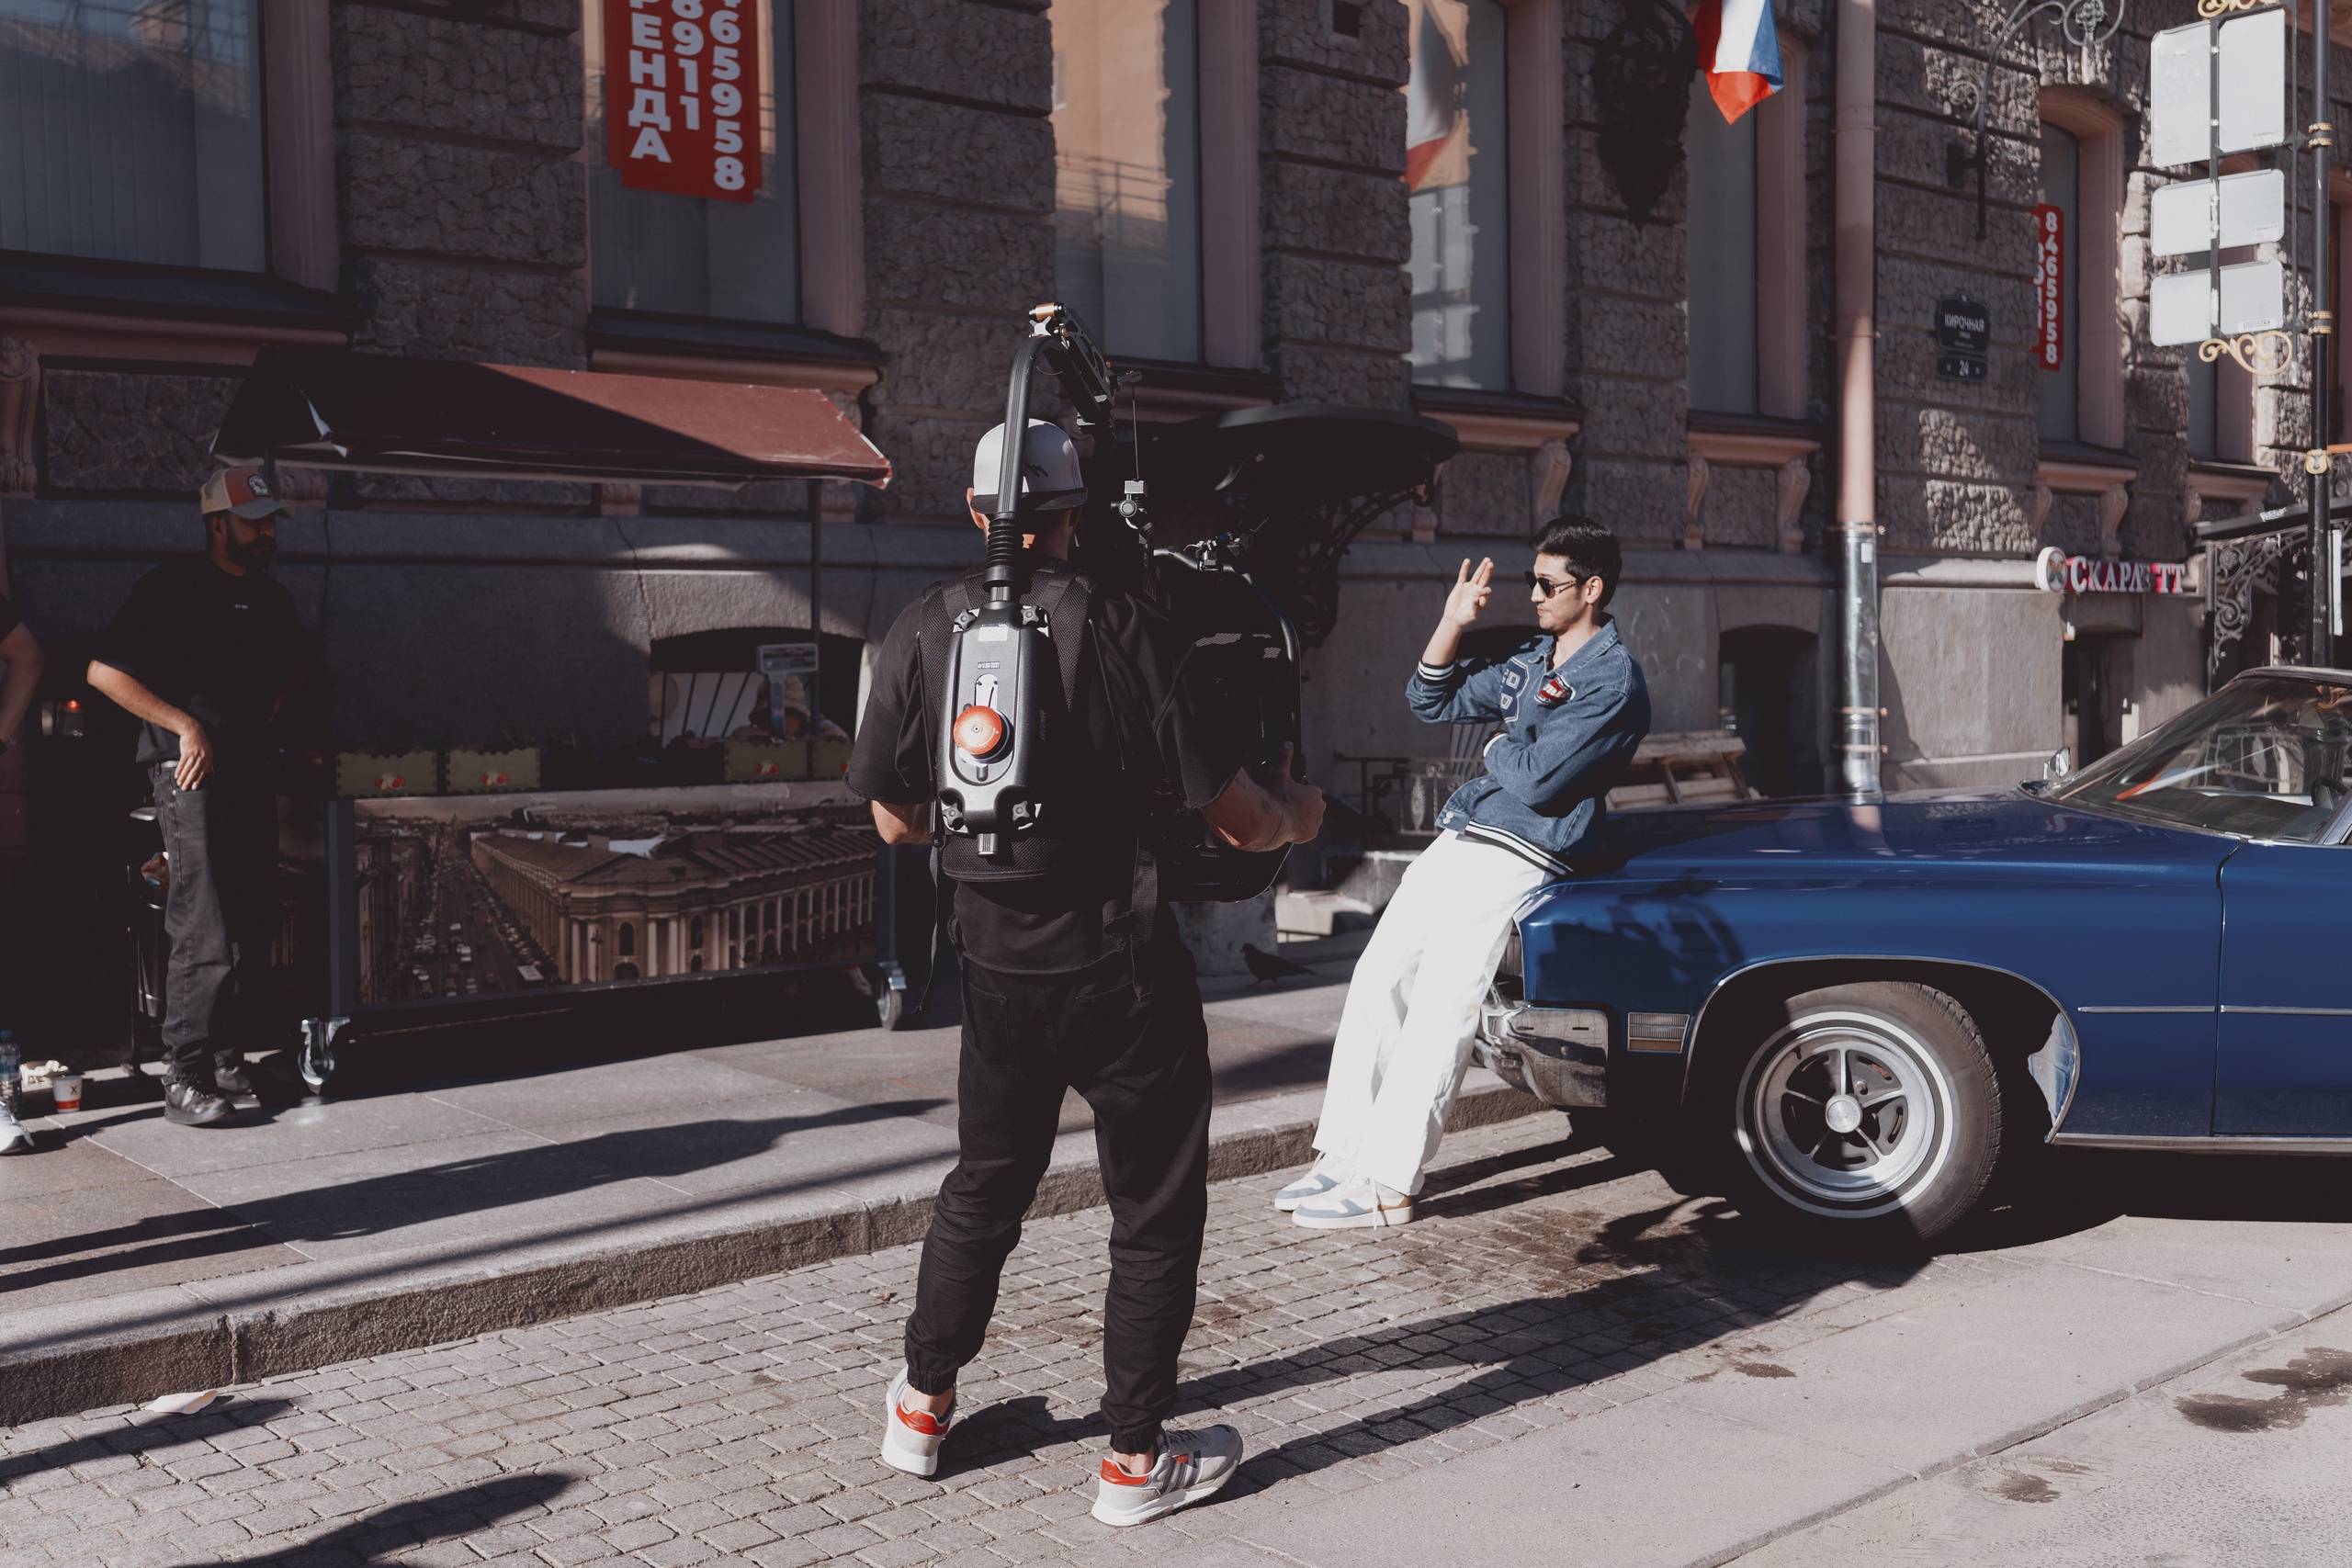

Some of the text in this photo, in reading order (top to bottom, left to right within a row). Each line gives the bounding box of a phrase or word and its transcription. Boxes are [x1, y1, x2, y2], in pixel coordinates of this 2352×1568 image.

[628, 0, 673, 164] ЕНДА
[709, 0, 745, 191] 65958
[1945, 313, 1984, 333] КИРОЧНАЯ
[2045, 211, 2058, 364] 8465958
[1959, 360, 1970, 377] 24
[2071, 556, 2186, 593] СКАРЛТТ
